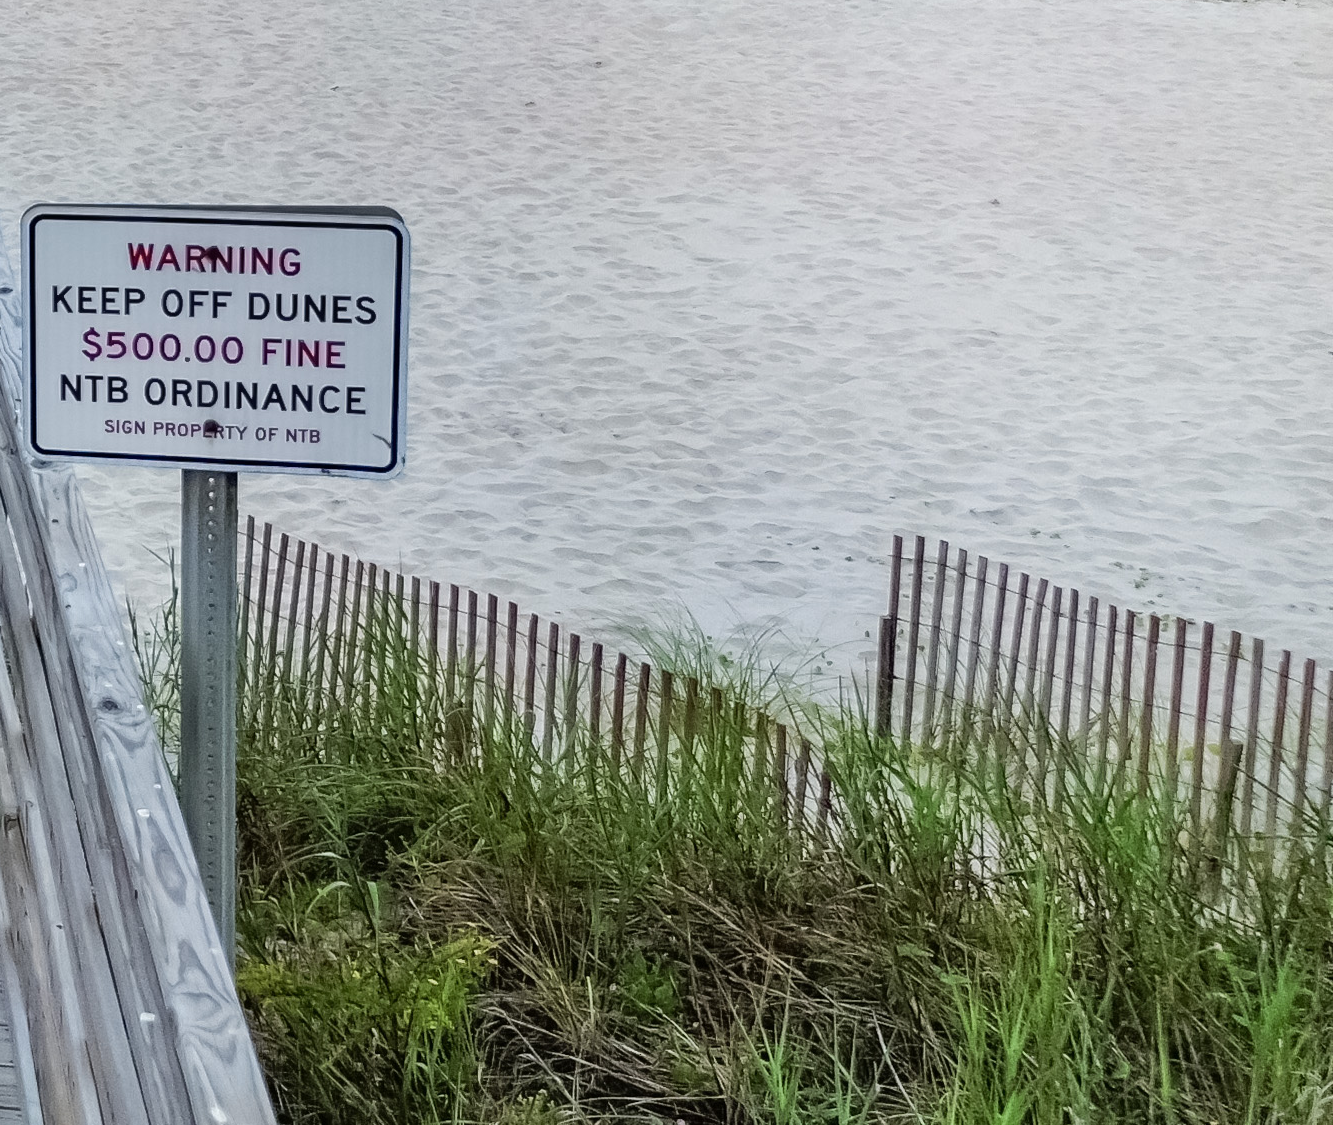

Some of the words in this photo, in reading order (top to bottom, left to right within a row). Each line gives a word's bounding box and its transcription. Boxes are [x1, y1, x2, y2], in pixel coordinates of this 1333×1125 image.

[128, 242, 301, 276] WARNING
[51, 285, 145, 315] KEEP
[161, 290, 232, 318] OFF
[248, 292, 377, 325] DUNES
[82, 327, 244, 363] $500.00
[261, 339, 347, 369] FINE
[60, 374, 128, 404] NTB
[145, 378, 366, 415] ORDINANCE
[104, 419, 145, 435] SIGN
[255, 427, 278, 442] OF
[286, 428, 321, 444] NTB
